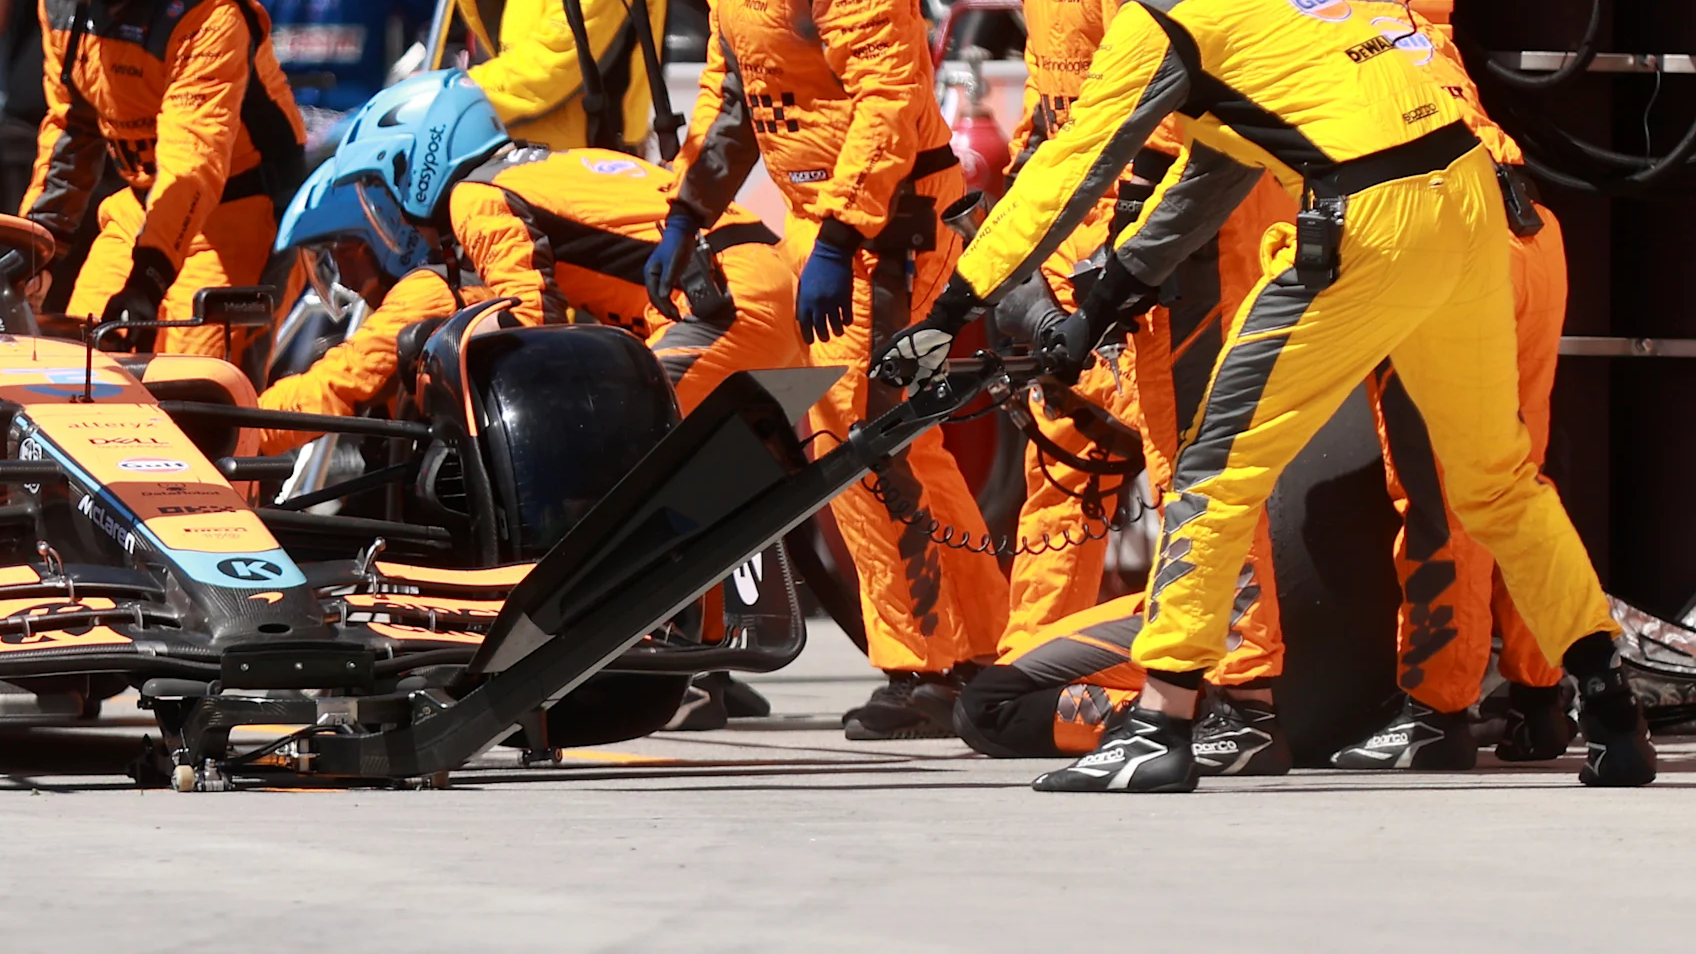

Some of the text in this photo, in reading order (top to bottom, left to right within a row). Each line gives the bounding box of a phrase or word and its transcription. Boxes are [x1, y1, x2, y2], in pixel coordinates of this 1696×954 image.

[1346, 34, 1396, 64] DeWA
[415, 123, 447, 203] easypost.
[67, 419, 158, 431] alteryx
[87, 437, 170, 446] DELL
[120, 461, 188, 470] Gulf
[141, 489, 221, 497] DataRobot
[77, 494, 136, 555] McLaren
[230, 559, 270, 580] K
[1191, 738, 1238, 756] parco
[1365, 732, 1409, 750] sparco
[1076, 746, 1126, 767] sparco
